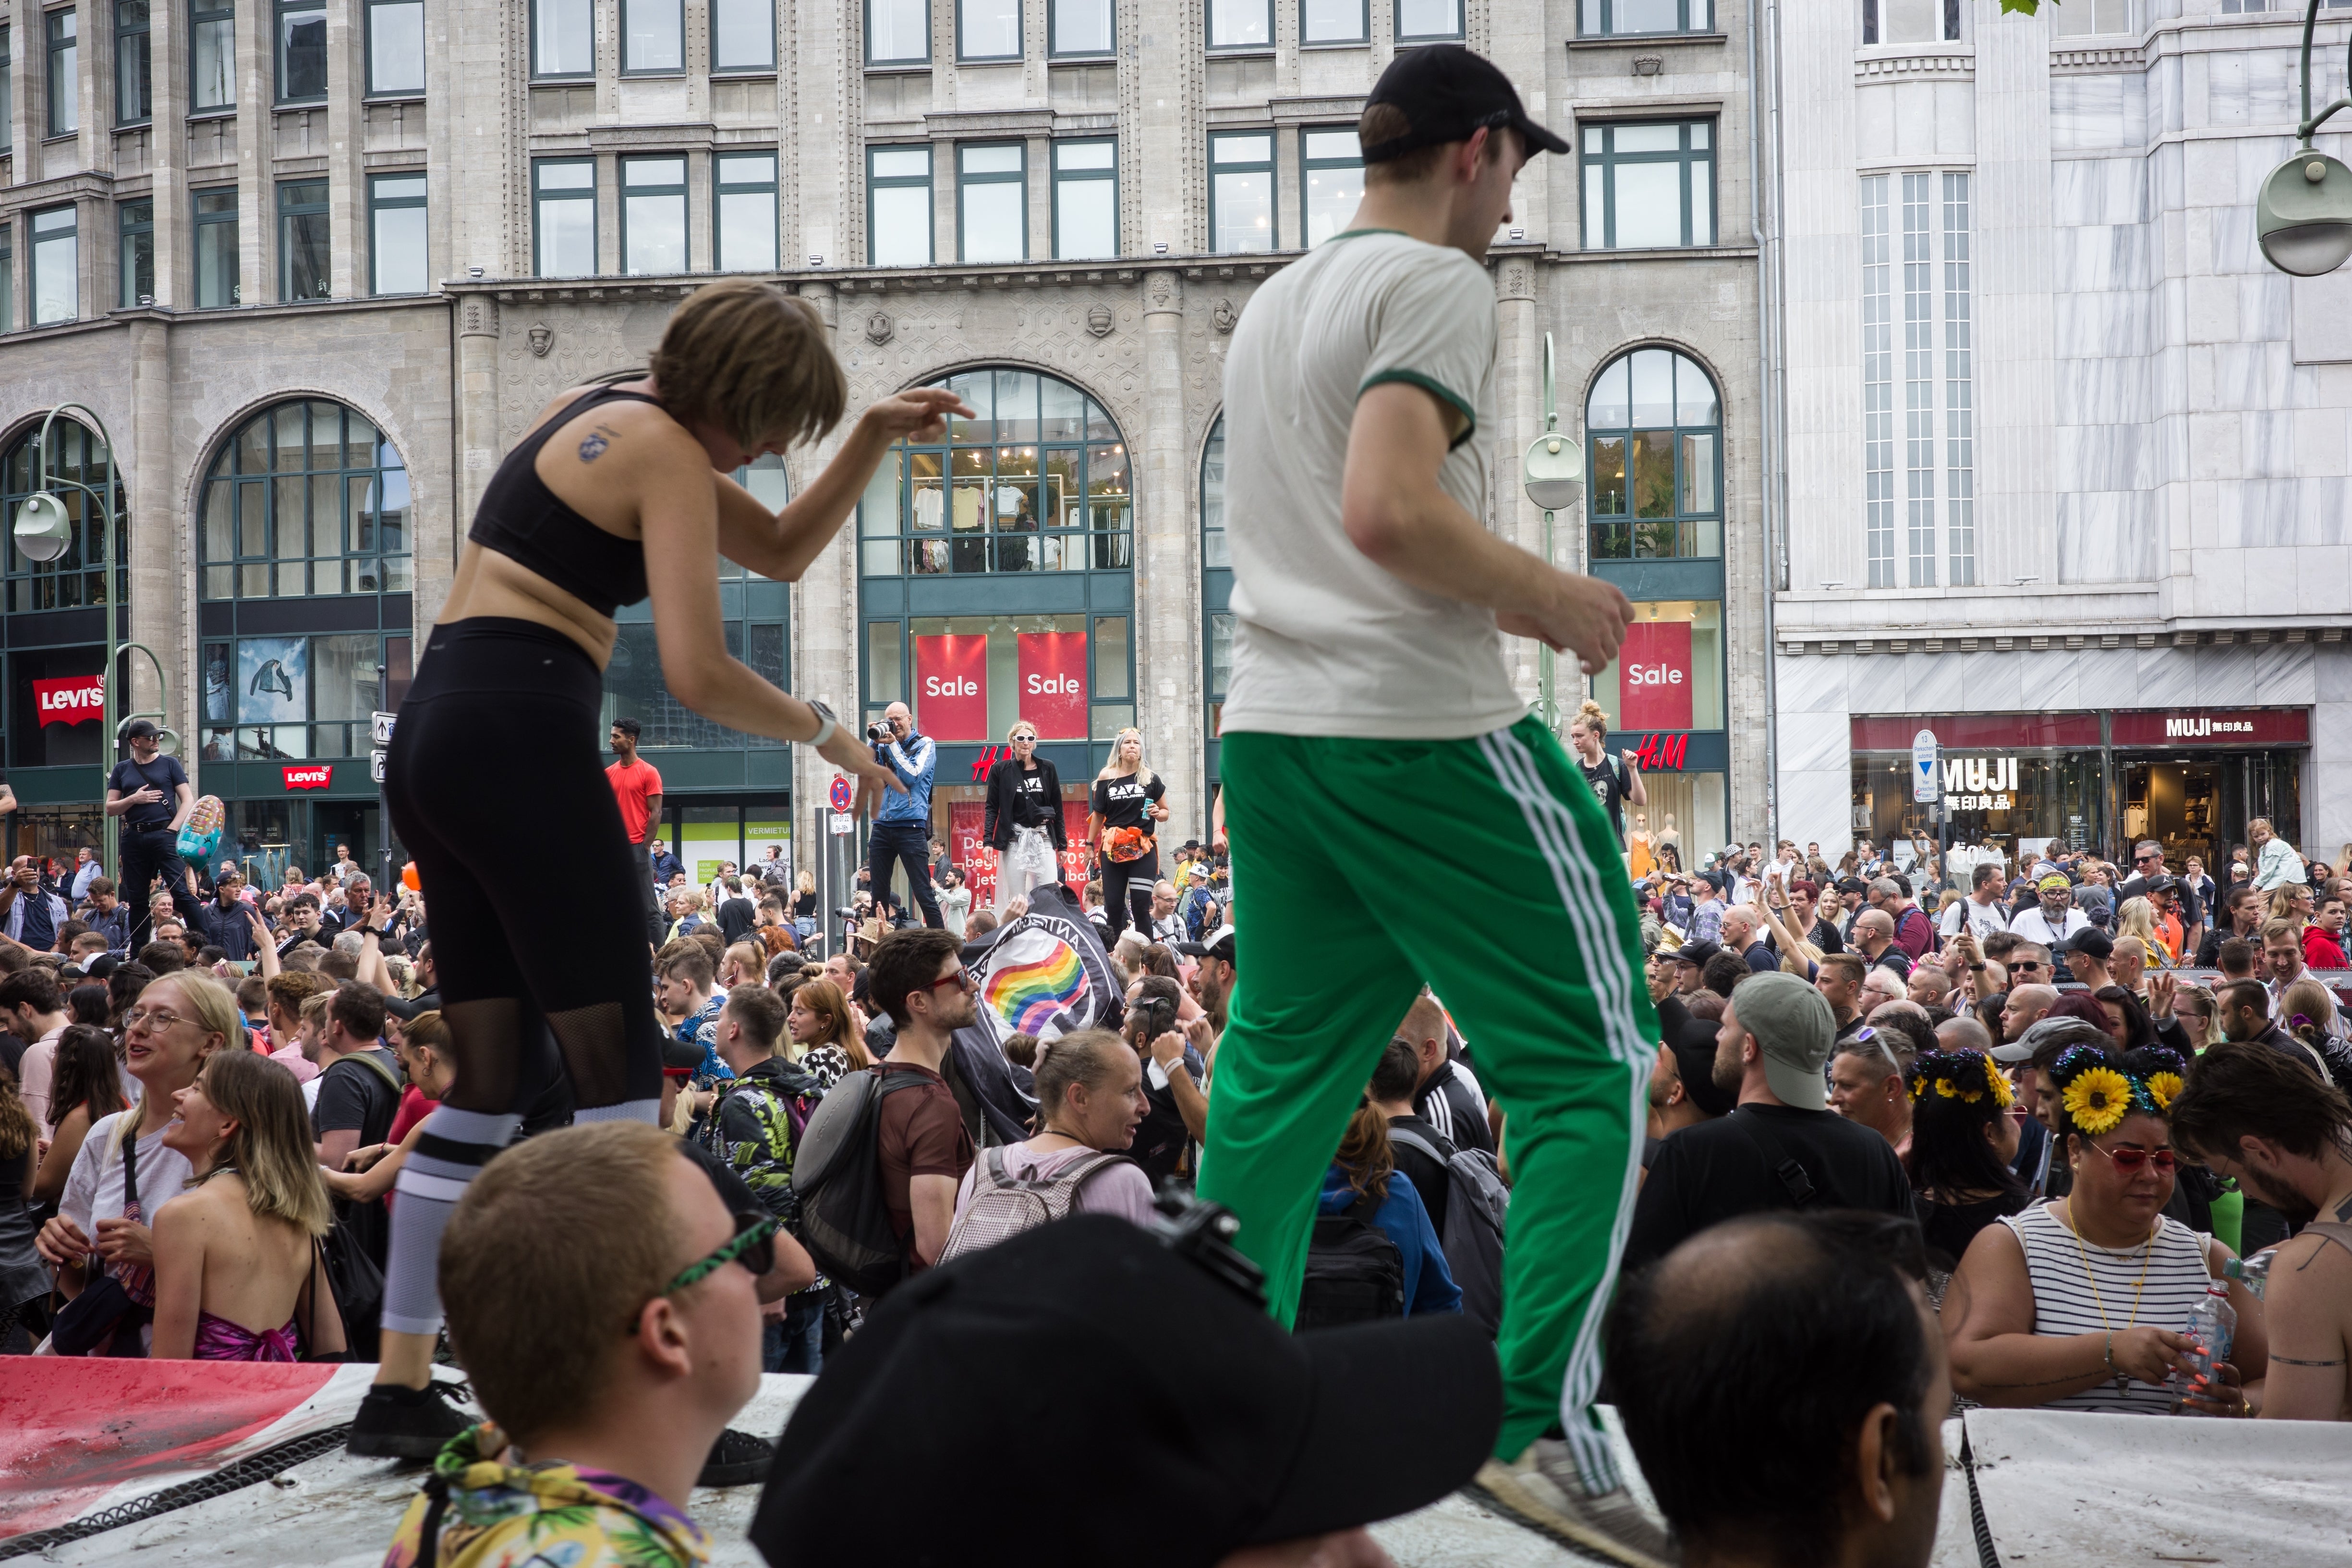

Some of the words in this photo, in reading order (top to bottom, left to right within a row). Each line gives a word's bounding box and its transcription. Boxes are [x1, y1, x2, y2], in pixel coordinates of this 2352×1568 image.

[1028, 673, 1079, 694] Sale
[1629, 664, 1683, 685] Sale
[926, 676, 978, 696] Sale
[2166, 718, 2210, 737] MUJI
[2212, 721, 2253, 732] 無印良品
[1633, 733, 1688, 770] H&M
[1585, 774, 1611, 782] OLUTION
[1943, 757, 2018, 792] MUJI
[1944, 794, 2011, 811] 無印良品
[964, 837, 983, 849] De
[965, 854, 997, 871] begi
[975, 873, 997, 888] jet
